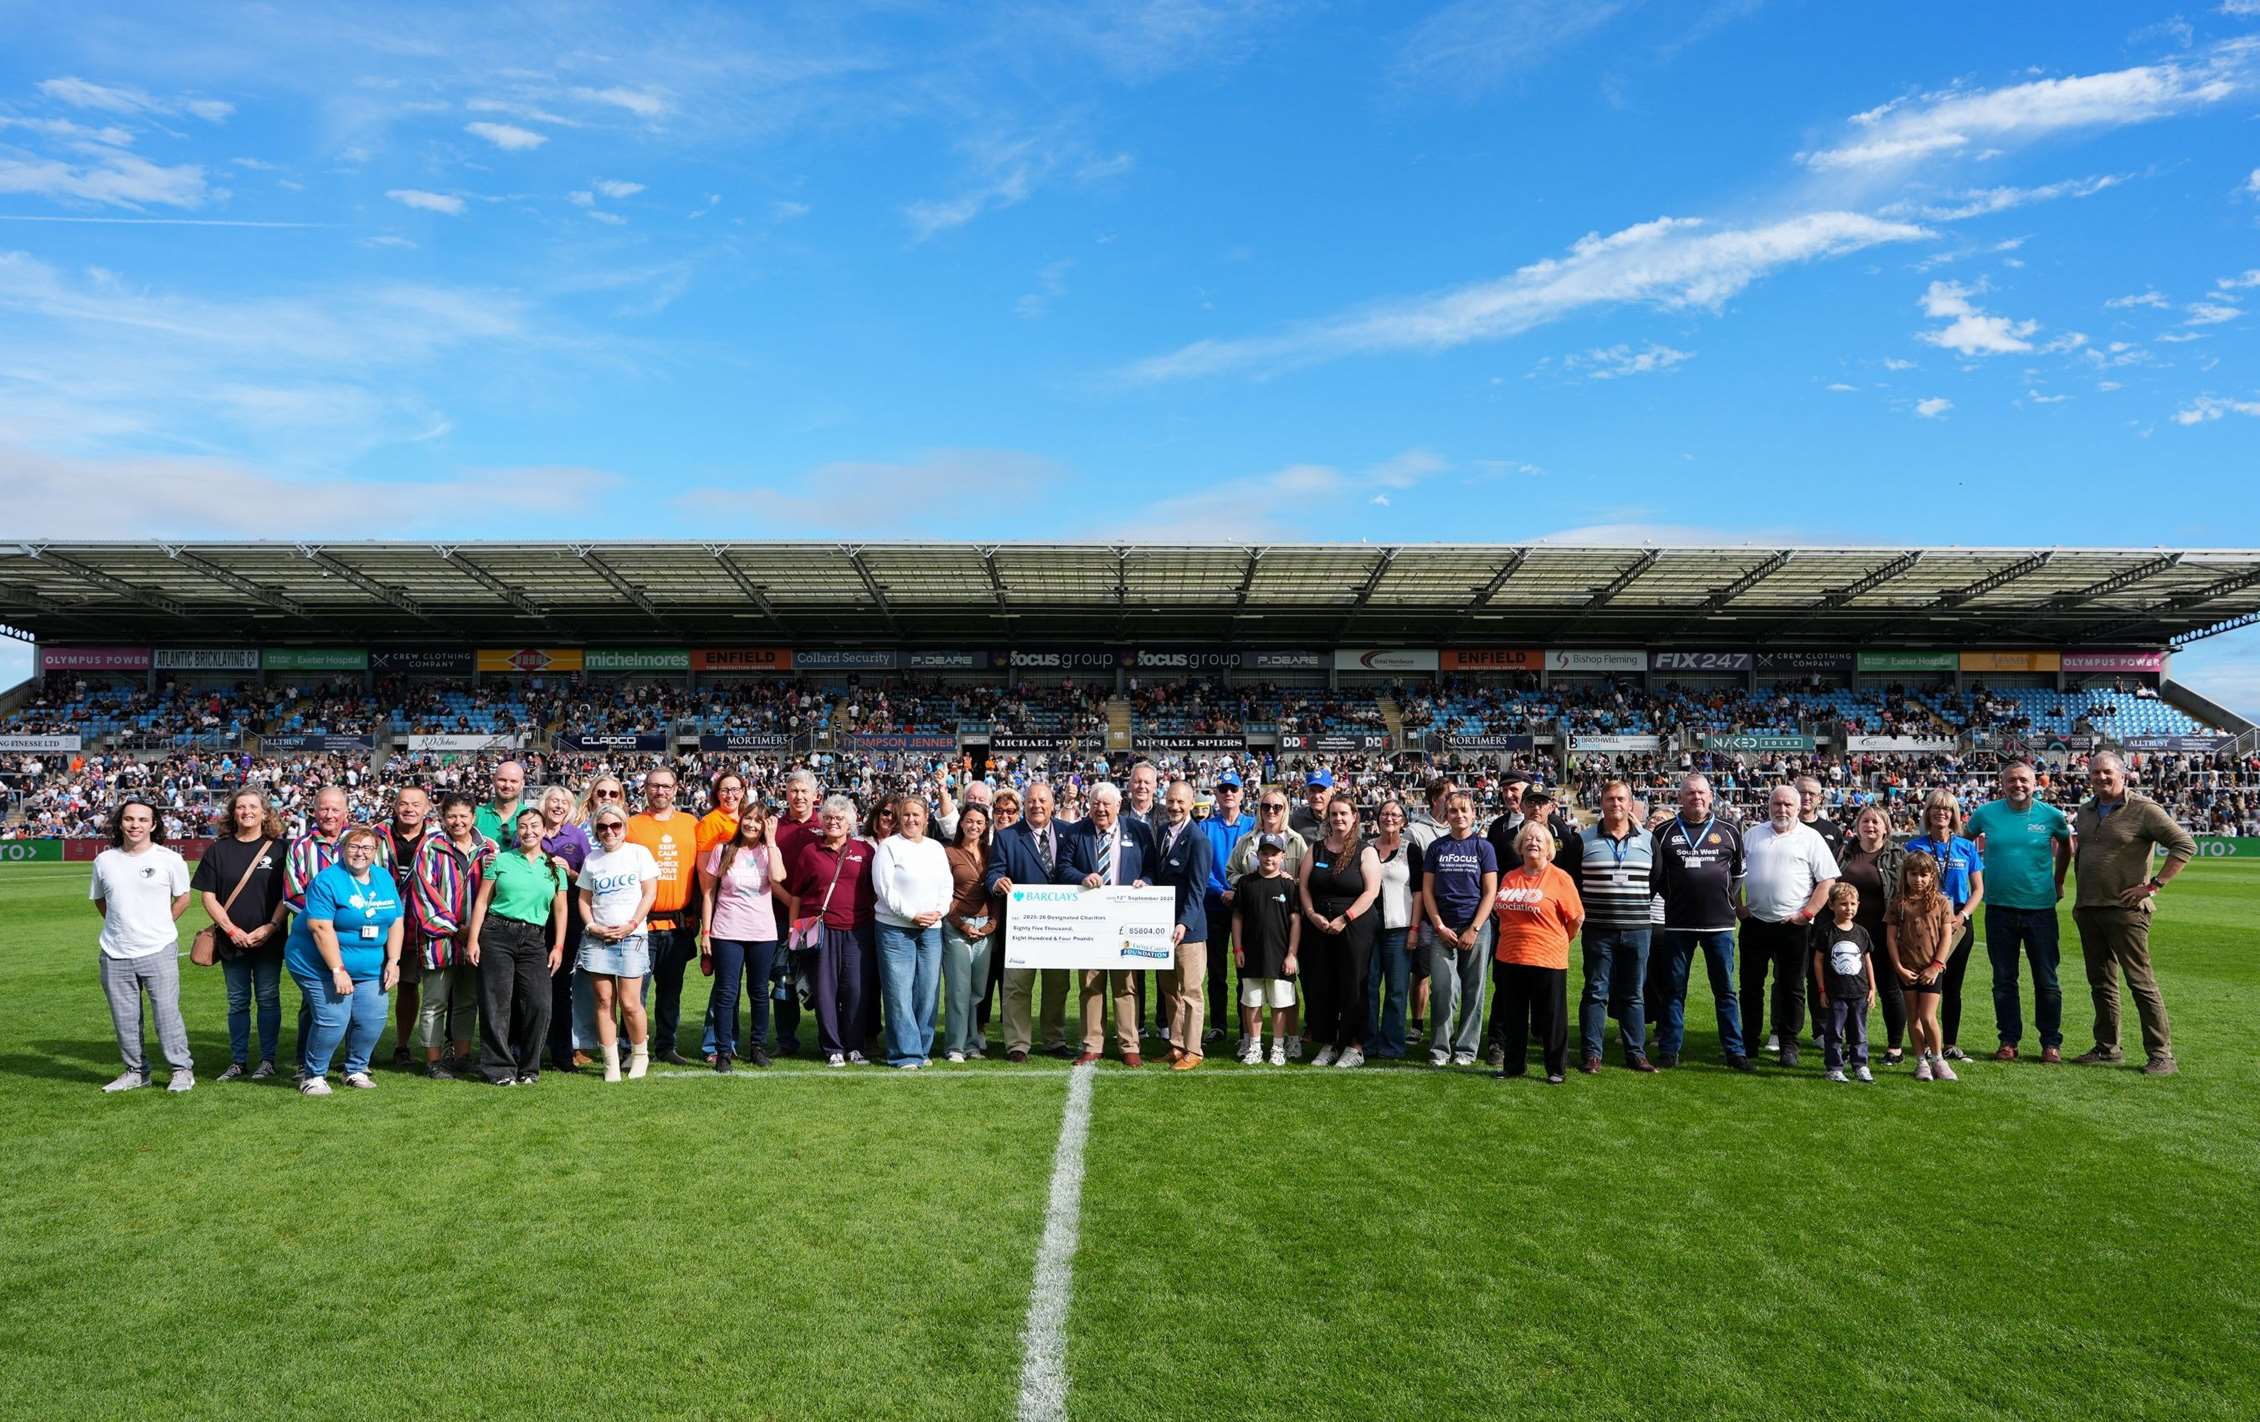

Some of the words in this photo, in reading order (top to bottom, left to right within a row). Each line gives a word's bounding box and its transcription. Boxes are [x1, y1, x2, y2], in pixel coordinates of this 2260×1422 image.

[45, 656, 101, 664] OLYMPUS
[106, 656, 149, 664] POWER
[156, 651, 193, 668] ATLANTIC
[194, 651, 245, 668] BRICKLAYING
[297, 656, 324, 664] Exeter
[327, 656, 361, 666] Hospital
[586, 651, 688, 667] michelmores
[706, 651, 776, 662] ENFIELD
[797, 653, 840, 664] Collard
[842, 653, 890, 665] Security
[1010, 651, 1060, 666] focus
[1061, 655, 1113, 668] group
[1137, 651, 1188, 665] focus
[1189, 655, 1240, 668] group
[1457, 651, 1526, 664] ENFIELD
[1573, 654, 1603, 665] Bishop
[1604, 654, 1638, 666] Fleming
[1655, 653, 1699, 668] FIX
[1700, 653, 1748, 668] 247
[1891, 656, 1917, 665] Exeter
[1918, 656, 1953, 666] Hospital
[408, 660, 456, 668] COMPANY
[2120, 658, 2160, 667] POWER
[582, 736, 637, 745] CLADCO
[727, 736, 788, 745] MORTIMERS
[843, 737, 906, 747] THOMPSON
[912, 737, 953, 747] JENNER
[995, 739, 1053, 747] MICHAEL
[1136, 739, 1194, 747] MICHAEL
[1196, 739, 1243, 747] SPIERS
[1283, 737, 1308, 748] DDF
[1713, 737, 1758, 747] NAKED
[2129, 739, 2169, 747] ALLTRUST
[1439, 854, 1478, 863] InFocus
[1026, 892, 1079, 902] BARCLAYS
[1496, 887, 1543, 903] MND
[1496, 902, 1541, 913] ssociation
[1119, 926, 1124, 935] £
[1123, 949, 1167, 958] FOUNDATION
